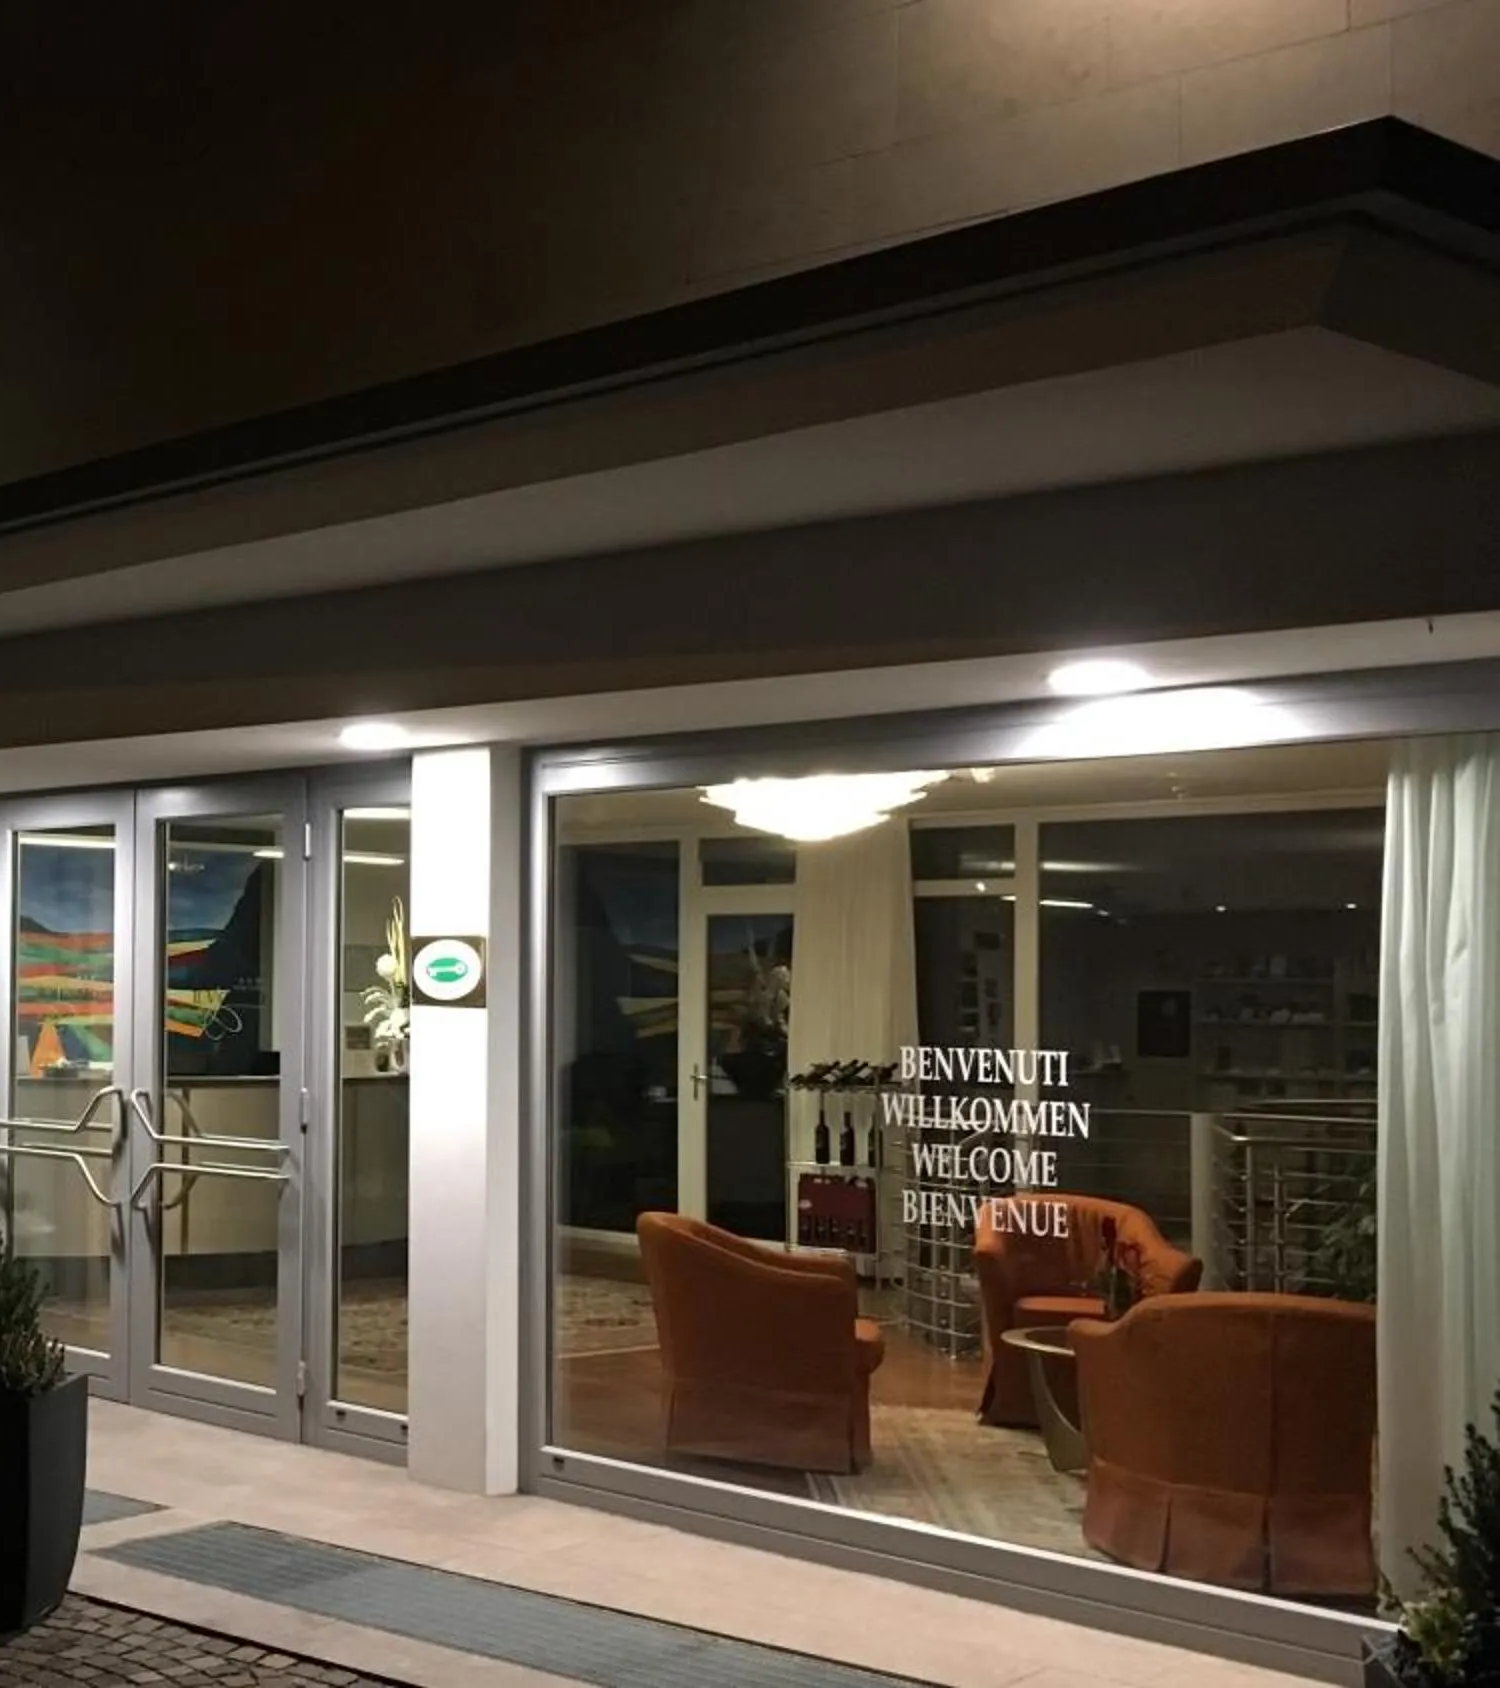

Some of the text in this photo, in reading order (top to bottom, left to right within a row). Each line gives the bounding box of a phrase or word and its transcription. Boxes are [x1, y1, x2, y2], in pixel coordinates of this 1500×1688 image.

[900, 1046, 1070, 1087] BENVENUTI
[881, 1093, 1091, 1139] WILLKOMMEN
[912, 1144, 1058, 1187] WELCOME
[902, 1189, 1069, 1239] BIENVENUE
